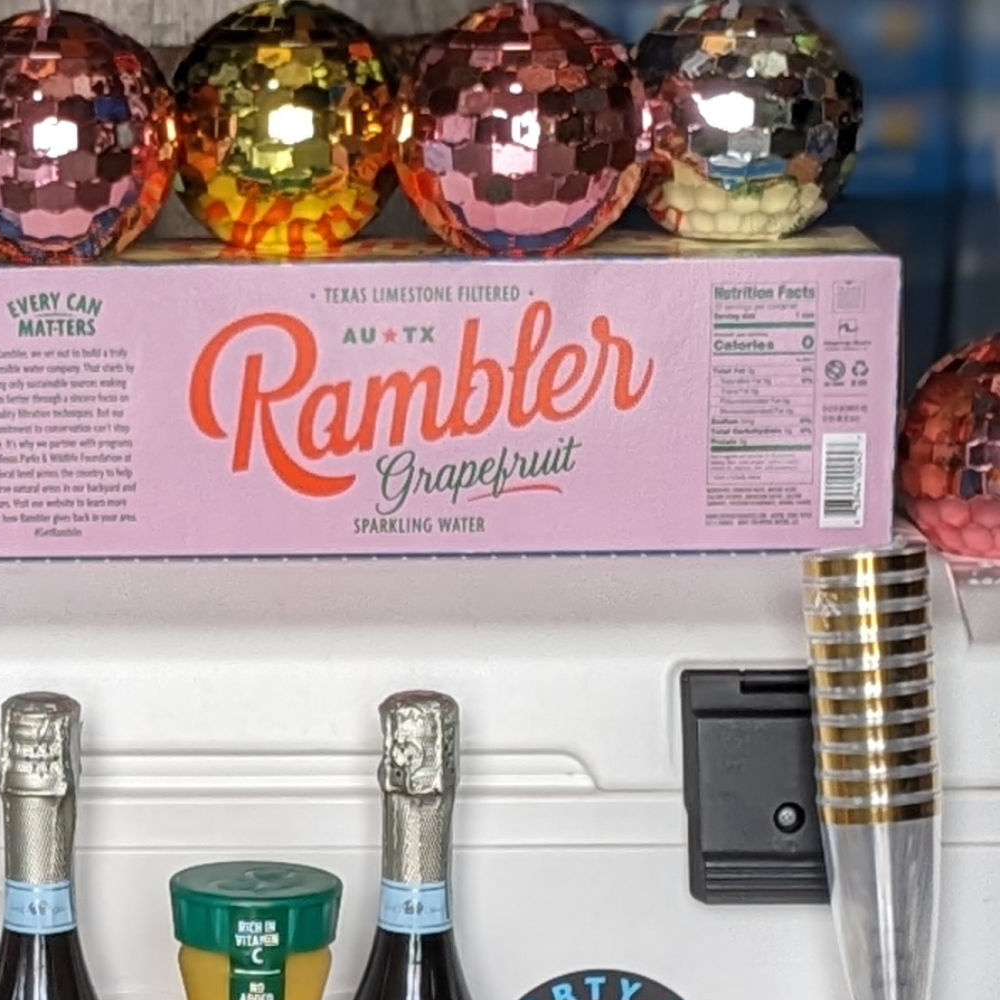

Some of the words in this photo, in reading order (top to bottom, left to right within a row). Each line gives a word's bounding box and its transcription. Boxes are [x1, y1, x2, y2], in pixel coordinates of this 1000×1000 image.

[324, 287, 368, 304] TEXAS
[372, 287, 450, 303] LIMESTONE
[458, 286, 520, 303] FILTERED
[778, 285, 815, 299] Facts
[6, 292, 60, 318] EVERY
[67, 293, 103, 317] CAN
[18, 319, 96, 337] MATTERS
[342, 327, 376, 344] AU
[403, 327, 435, 344] TX
[714, 340, 774, 350] Calories
[189, 300, 654, 497] Rambler
[375, 436, 582, 515] Grapefruit
[353, 517, 433, 534] SPARKLING
[438, 517, 485, 533] WATER
[238, 920, 262, 933] RICH
[265, 920, 276, 932] IN
[251, 947, 264, 964] C
